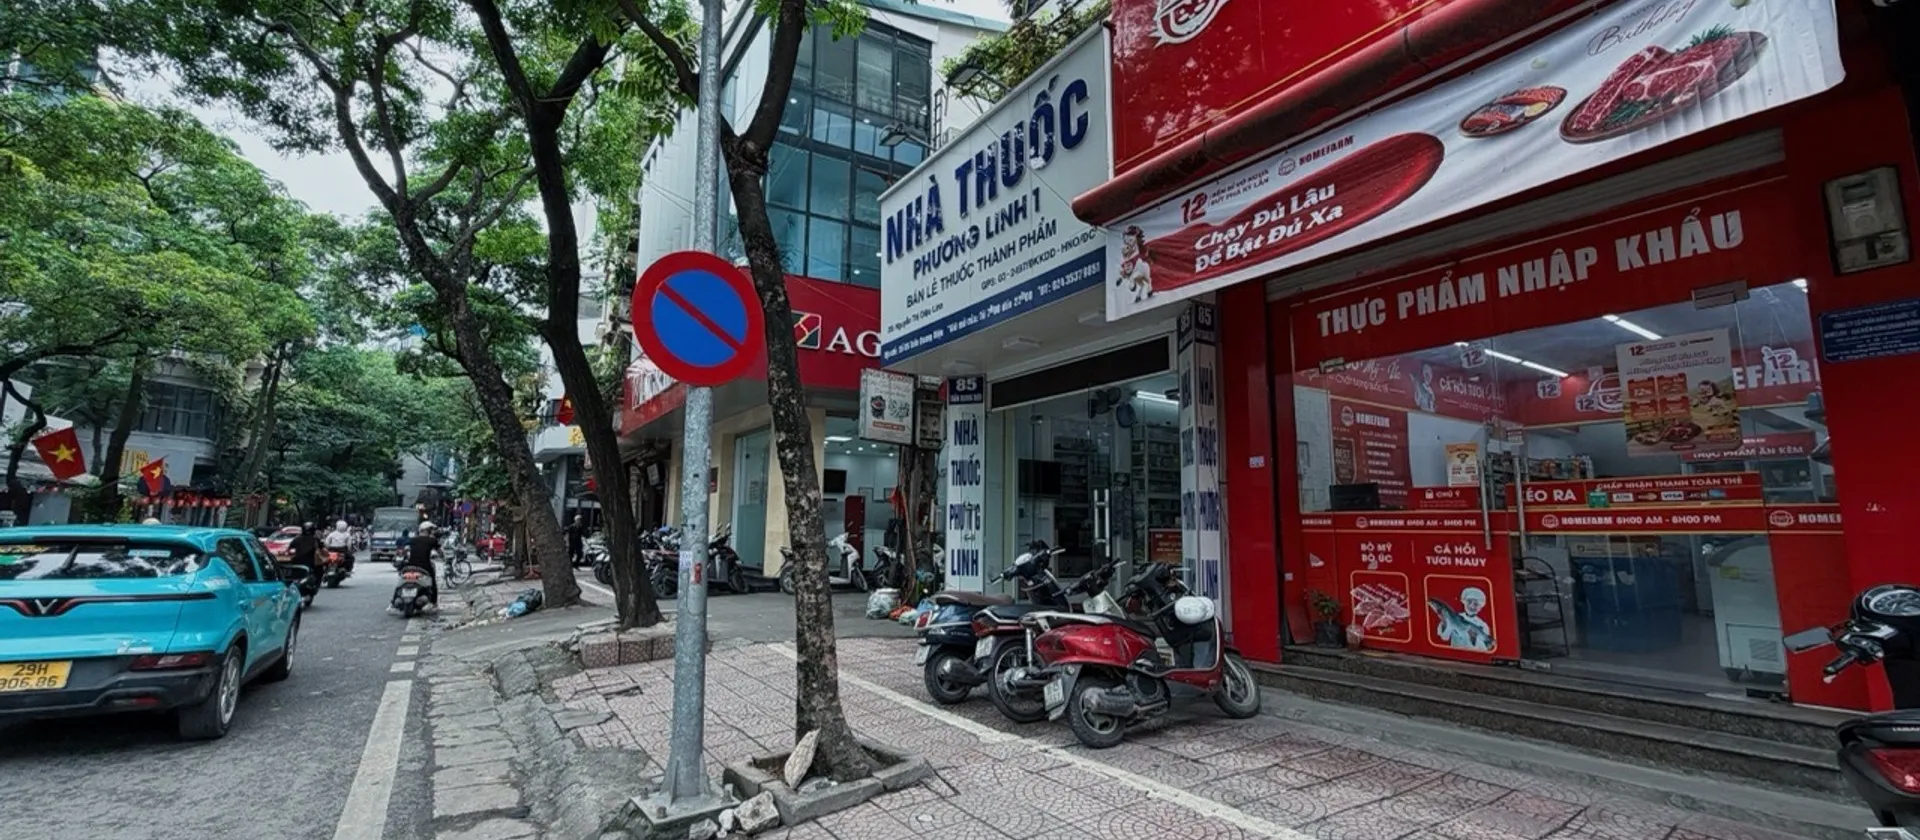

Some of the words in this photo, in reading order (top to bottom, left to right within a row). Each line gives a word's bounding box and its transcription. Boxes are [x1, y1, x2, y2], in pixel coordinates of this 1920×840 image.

[1299, 135, 1354, 165] HOMEFARM
[887, 174, 944, 264] NHÀ
[955, 74, 1089, 219] THUỐC
[1194, 221, 1249, 250] Chạy
[1252, 202, 1286, 229] Đủ
[1290, 184, 1335, 215] Lâu
[1226, 235, 1264, 259] Bật
[1267, 218, 1303, 244] Đủ
[1305, 205, 1343, 230] Xa
[913, 224, 980, 280] PHƯƠNG
[985, 194, 1028, 240] LINH
[1032, 187, 1041, 213] 1
[940, 261, 975, 292] THUỐC
[977, 240, 1017, 272] THÀNH
[1317, 296, 1387, 337] THỰC
[1398, 269, 1486, 319] PHẨM
[1497, 246, 1599, 298] NHẬP
[1615, 207, 1744, 271] KHẨU
[1768, 354, 1796, 370] 12
[956, 378, 977, 391] 85
[953, 414, 979, 446] NHÀ
[951, 453, 980, 487] THUỐC
[1655, 479, 1689, 488] THANH
[1524, 487, 1548, 502] ÉO
[1554, 488, 1577, 501] RA
[1561, 515, 1612, 525] HOMEFARM
[1645, 515, 1662, 524] AM
[1702, 514, 1721, 524] PM
[951, 549, 979, 577] LINH
[1434, 543, 1451, 555] CÁ
[13, 664, 48, 676] 29H
